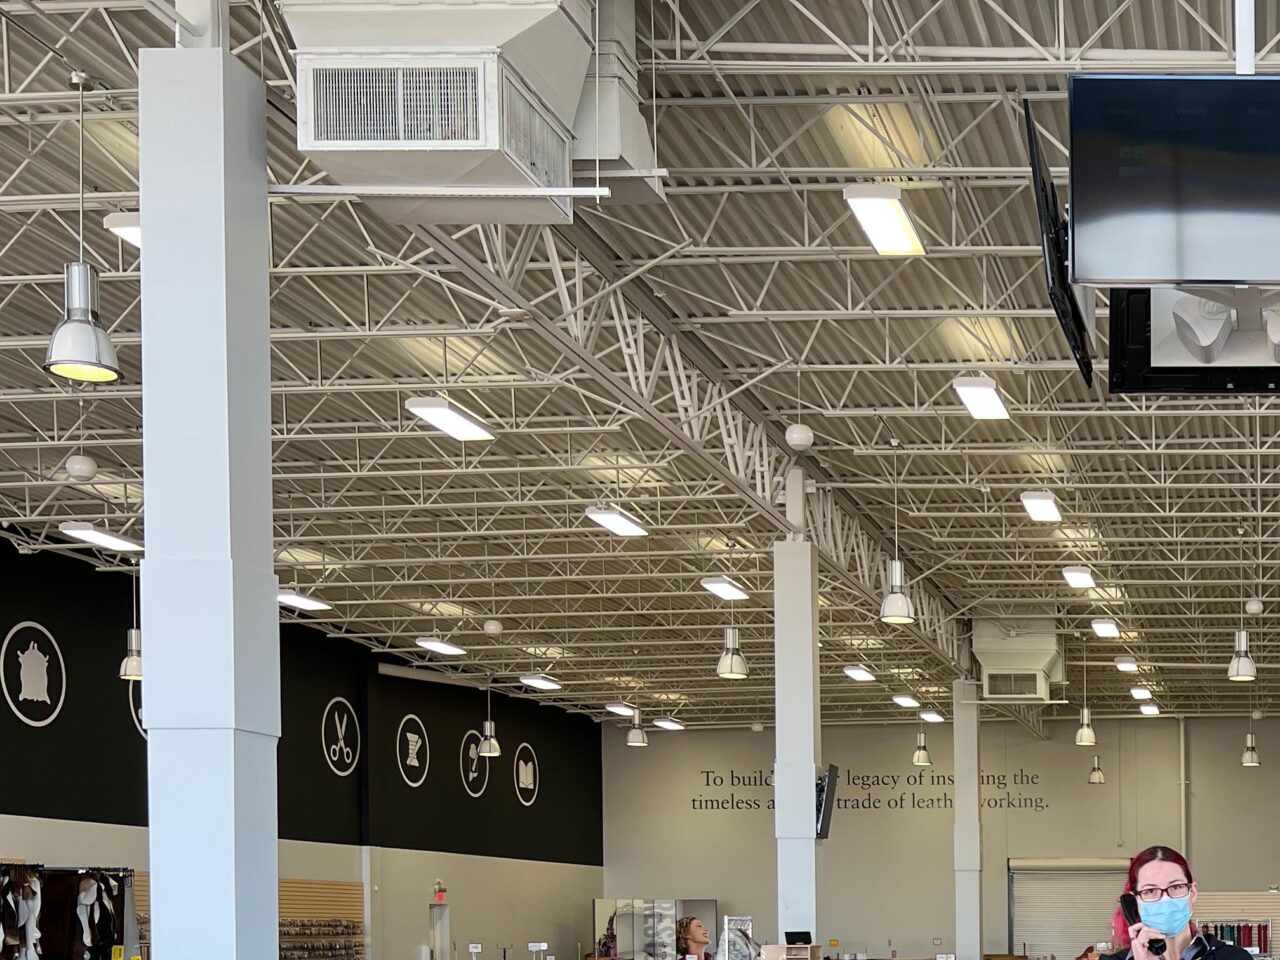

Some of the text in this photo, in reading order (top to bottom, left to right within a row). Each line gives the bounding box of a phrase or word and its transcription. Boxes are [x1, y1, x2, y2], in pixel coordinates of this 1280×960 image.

[701, 770, 724, 786] To
[847, 769, 899, 790] legacy
[906, 769, 925, 786] of
[930, 769, 1007, 790] insing
[1013, 768, 1039, 785] the
[692, 794, 761, 810] timeless
[837, 794, 881, 810] trade
[888, 793, 907, 810] of
